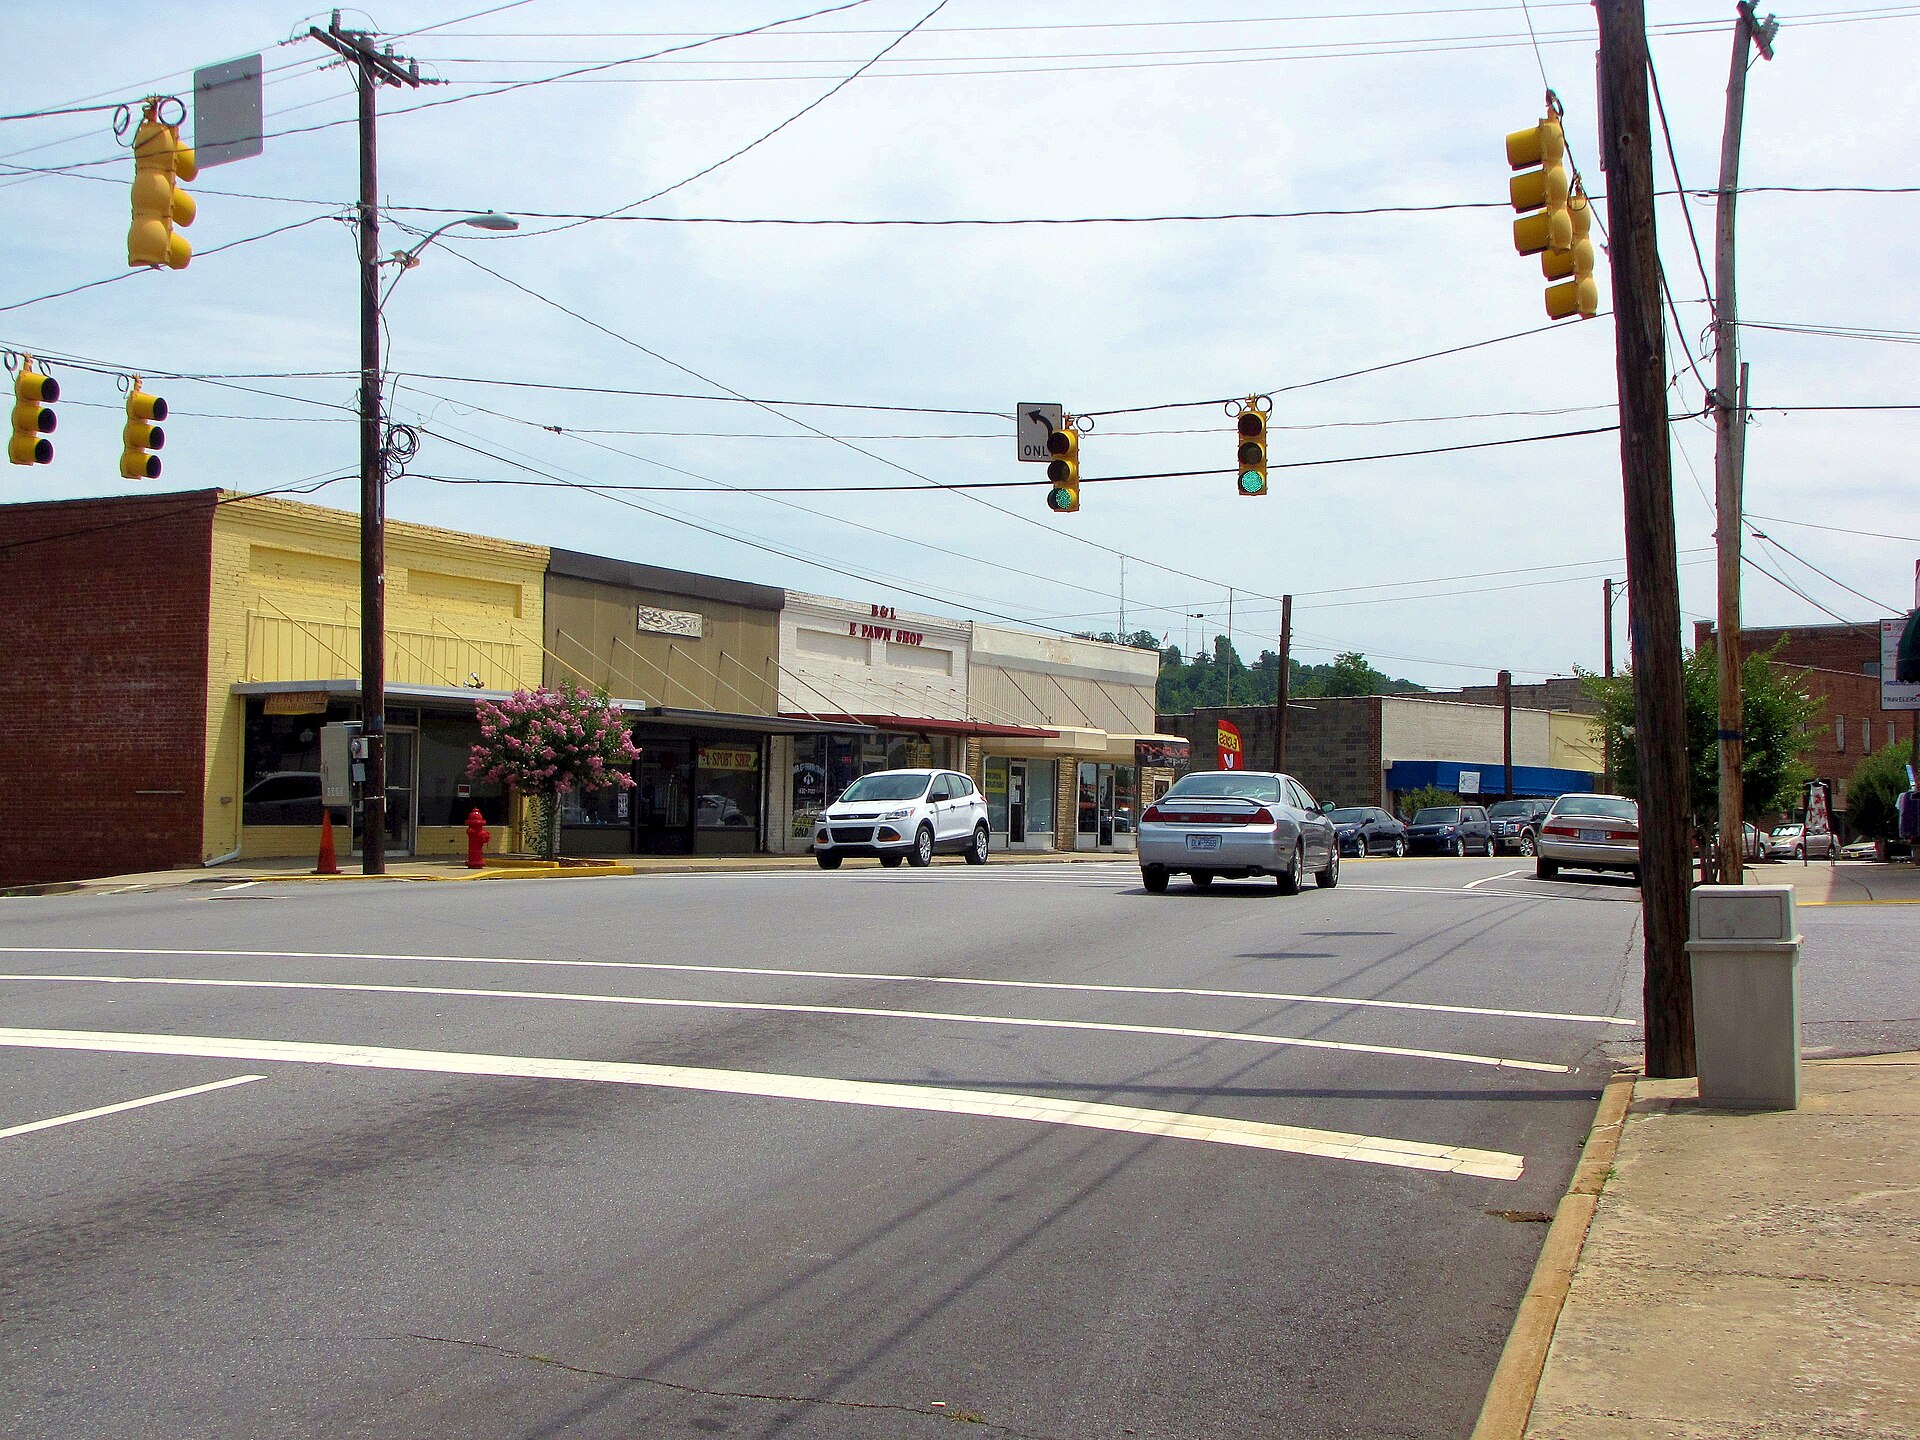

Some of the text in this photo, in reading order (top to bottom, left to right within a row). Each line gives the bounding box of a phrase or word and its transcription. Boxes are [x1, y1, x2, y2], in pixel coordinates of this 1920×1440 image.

[849, 622, 923, 645] E PAWN SHOP
